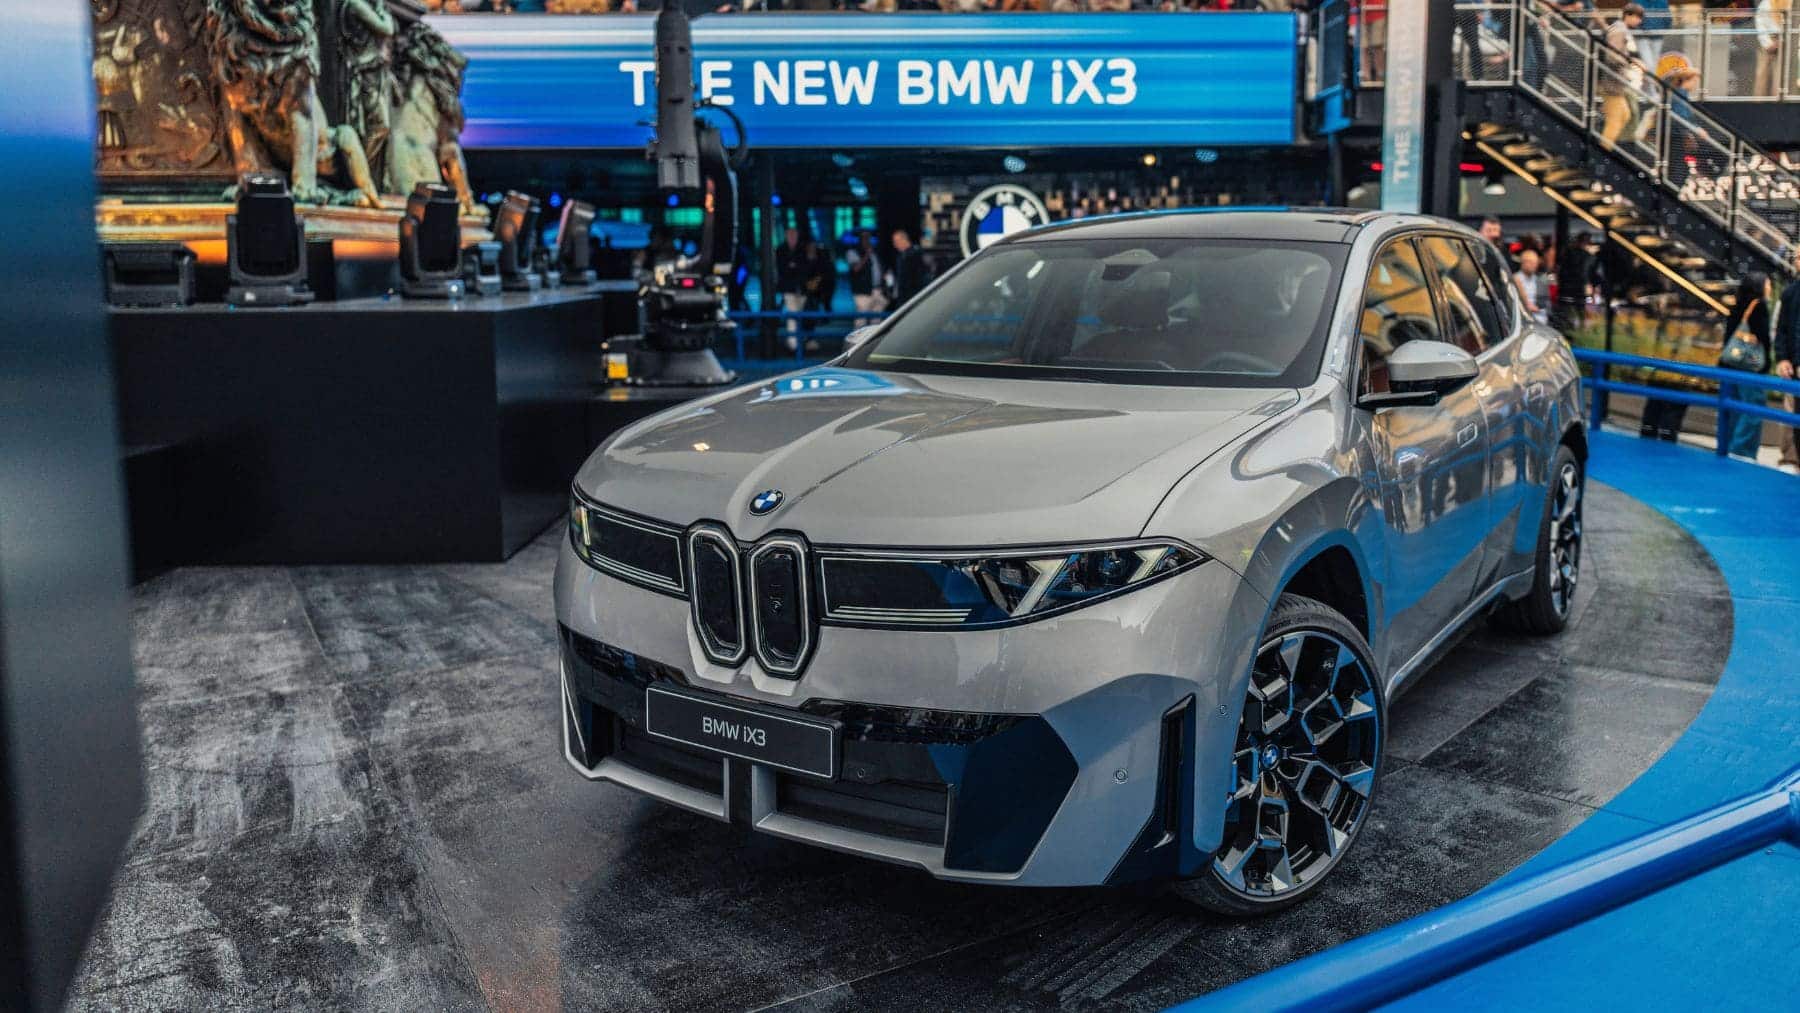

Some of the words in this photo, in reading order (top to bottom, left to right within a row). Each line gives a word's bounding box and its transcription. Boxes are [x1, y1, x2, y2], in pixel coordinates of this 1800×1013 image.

[619, 60, 734, 106] TE
[753, 60, 879, 106] NEW
[899, 60, 1034, 105] BMW
[1051, 58, 1138, 105] iX3
[1392, 130, 1411, 184] THE
[972, 191, 1038, 220] BMW
[702, 717, 740, 740] BMW
[743, 726, 767, 747] iX3
